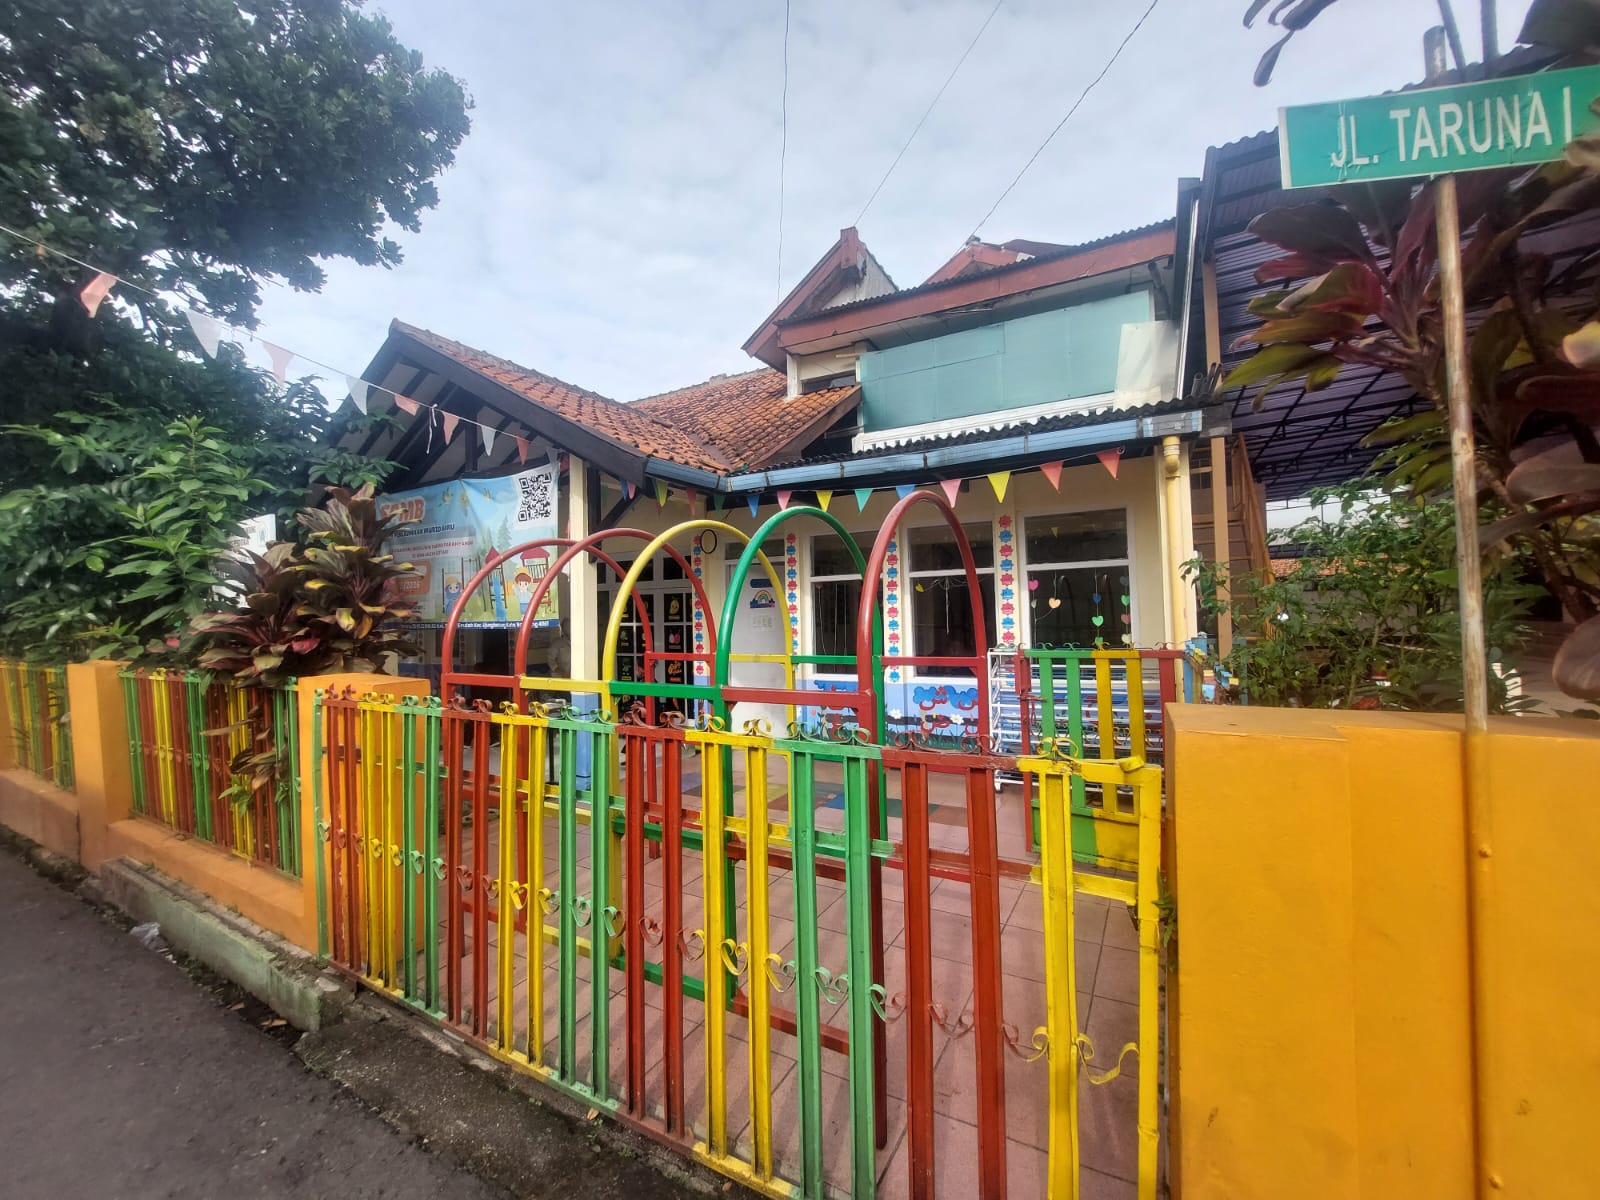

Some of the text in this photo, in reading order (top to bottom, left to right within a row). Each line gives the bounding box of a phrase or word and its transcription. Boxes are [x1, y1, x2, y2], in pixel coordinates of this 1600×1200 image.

[1330, 86, 1572, 167] JL. TARUNA I
